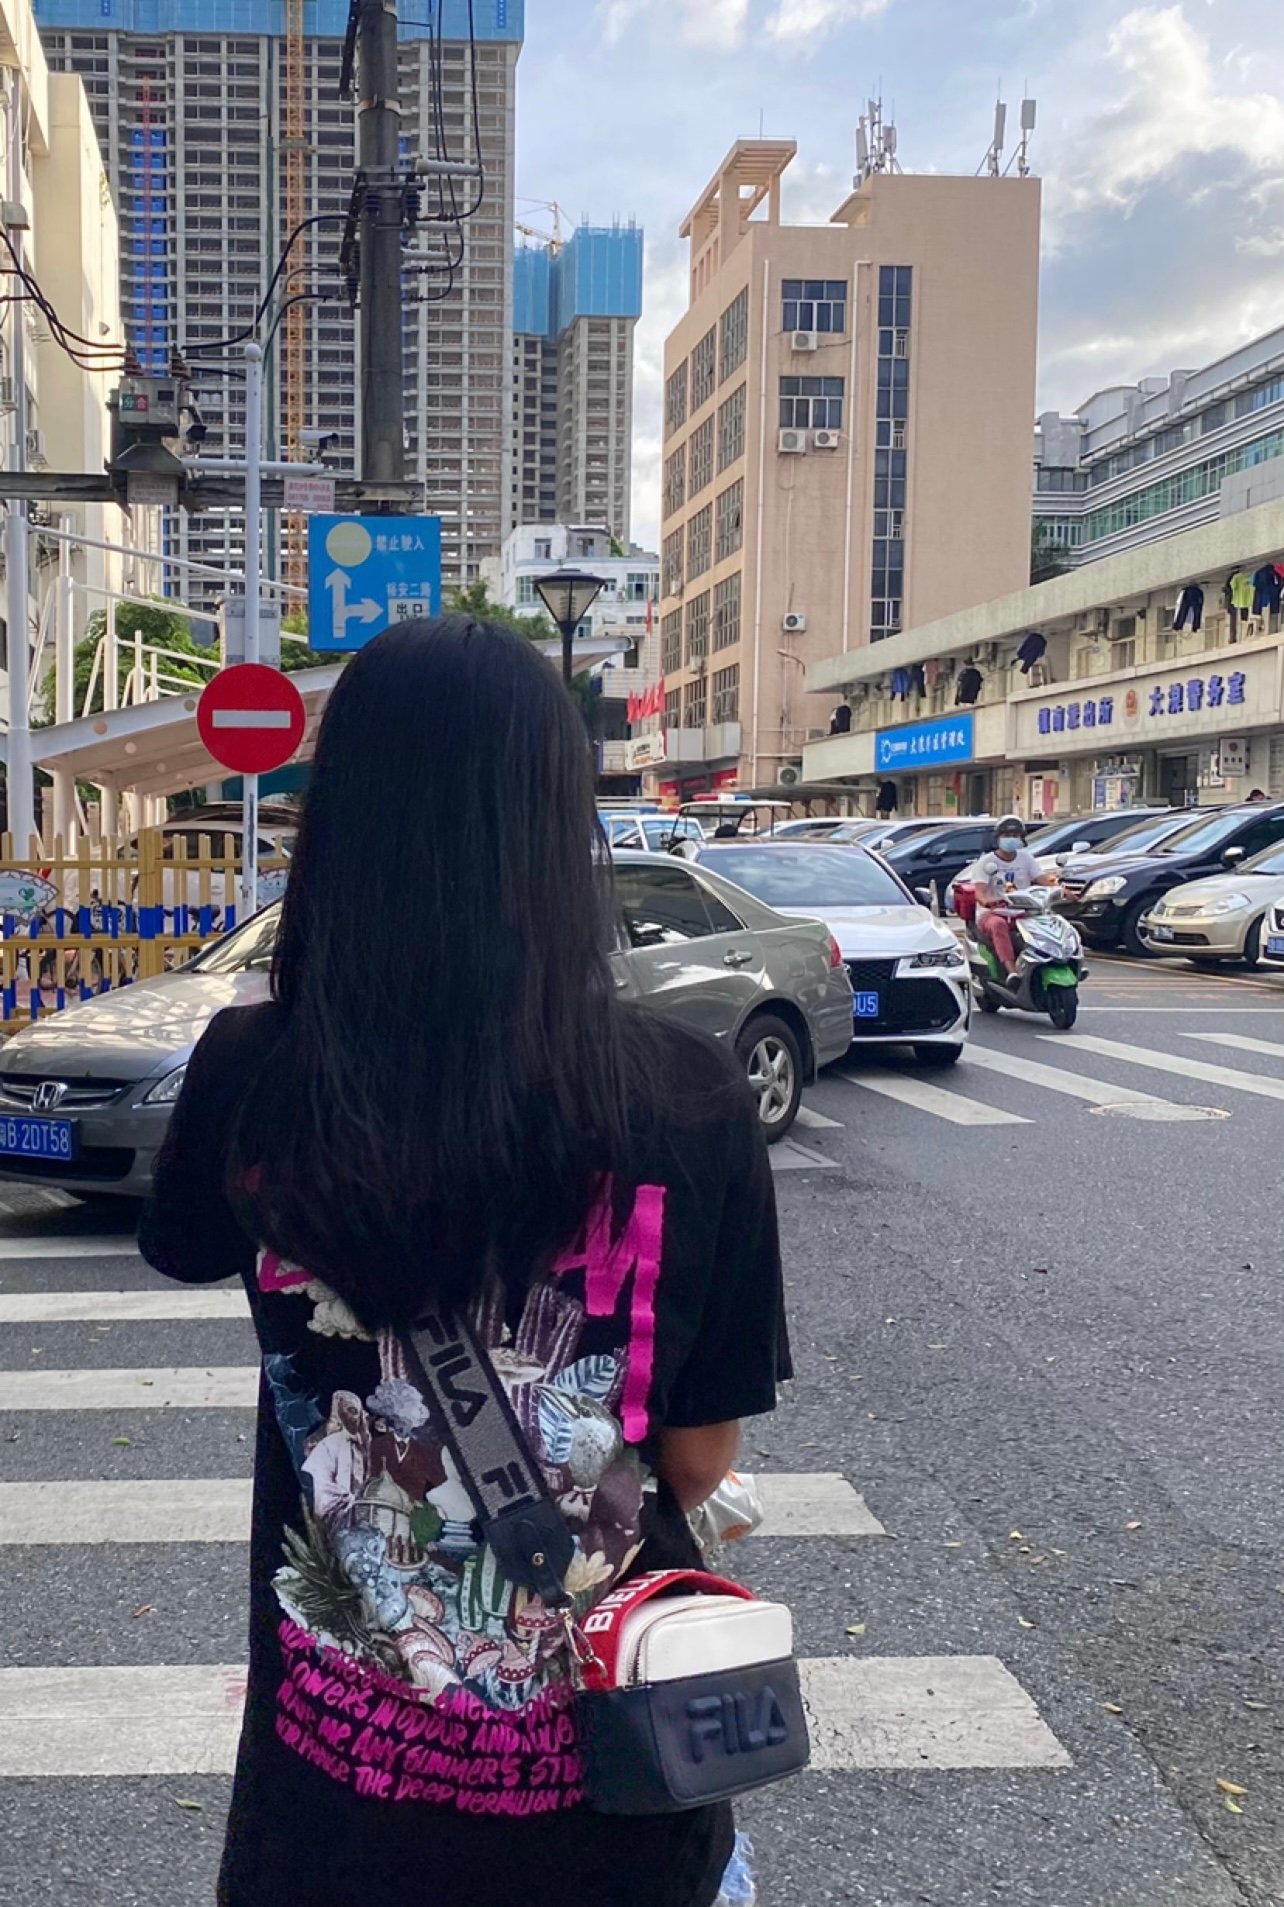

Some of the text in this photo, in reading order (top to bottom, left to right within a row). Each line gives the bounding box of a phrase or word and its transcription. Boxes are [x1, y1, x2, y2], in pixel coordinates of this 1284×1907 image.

[396, 602, 423, 615] 出口
[853, 995, 876, 1012] U5
[686, 1685, 787, 1763] FILA
[473, 1721, 520, 1754] AND
